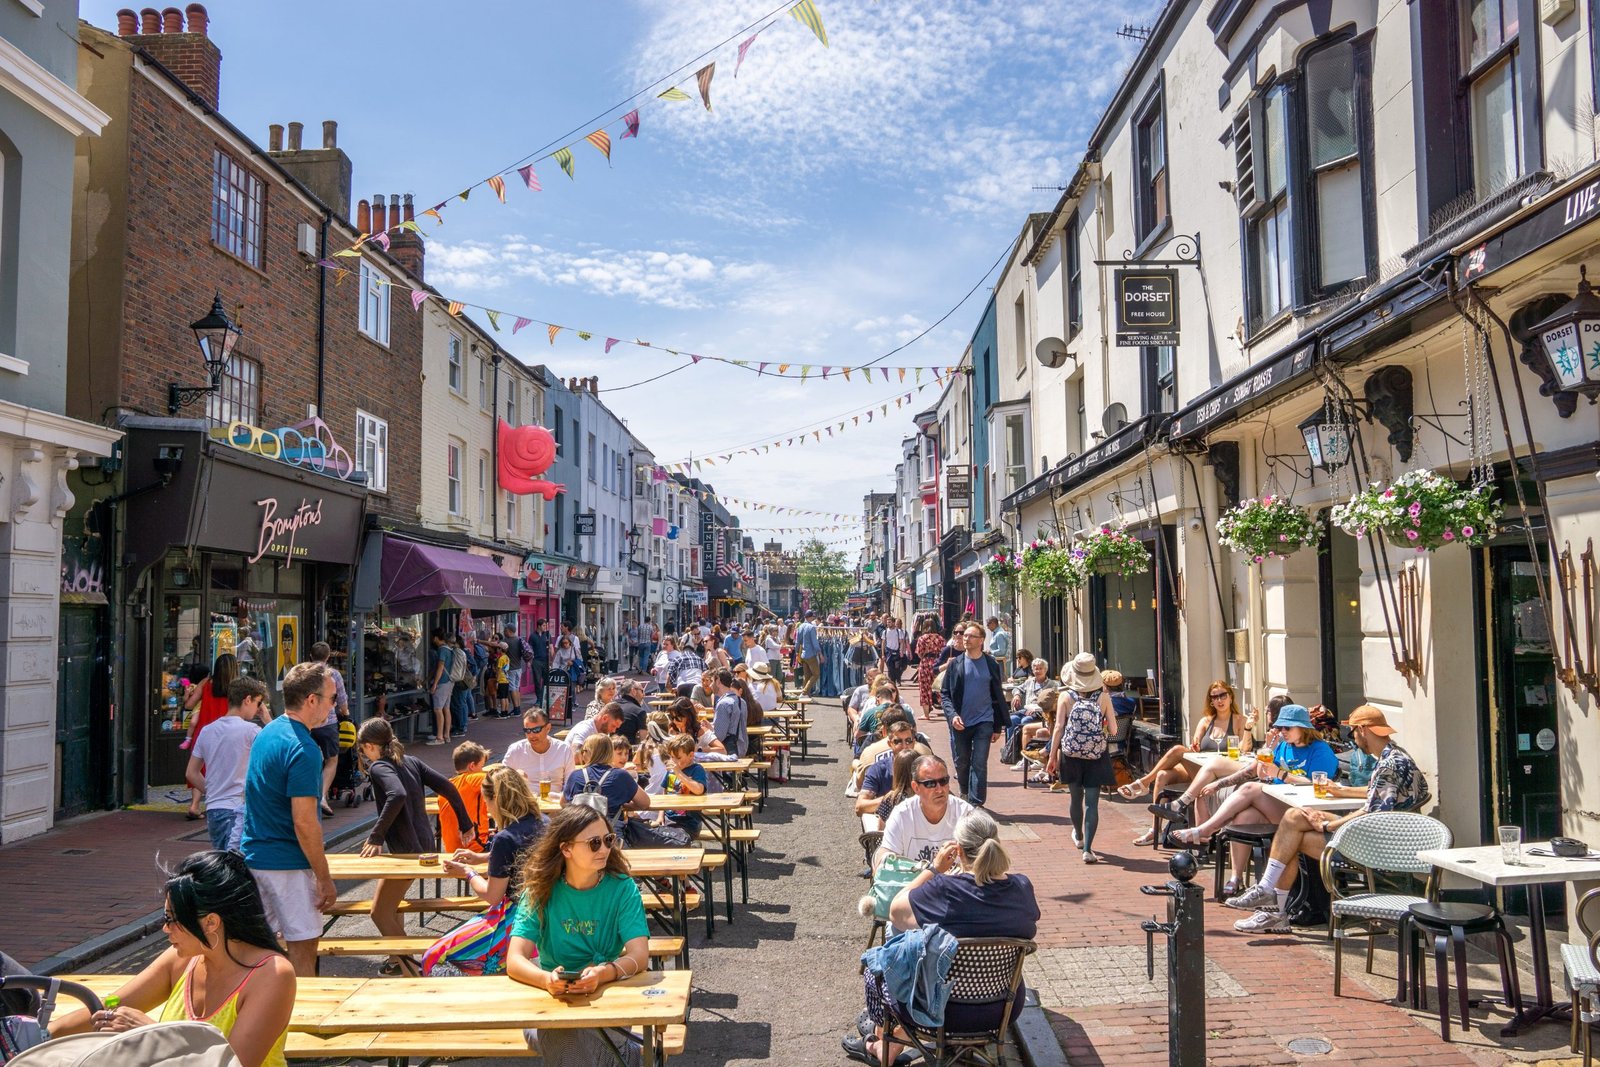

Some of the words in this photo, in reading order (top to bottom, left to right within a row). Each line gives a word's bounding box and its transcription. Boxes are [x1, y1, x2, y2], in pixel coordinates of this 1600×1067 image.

[1564, 182, 1600, 226] LIVE
[1125, 292, 1170, 302] DORSET
[1545, 326, 1574, 343] DORSET
[248, 498, 323, 569] Bromptons
[270, 543, 308, 556] OPTIIANS
